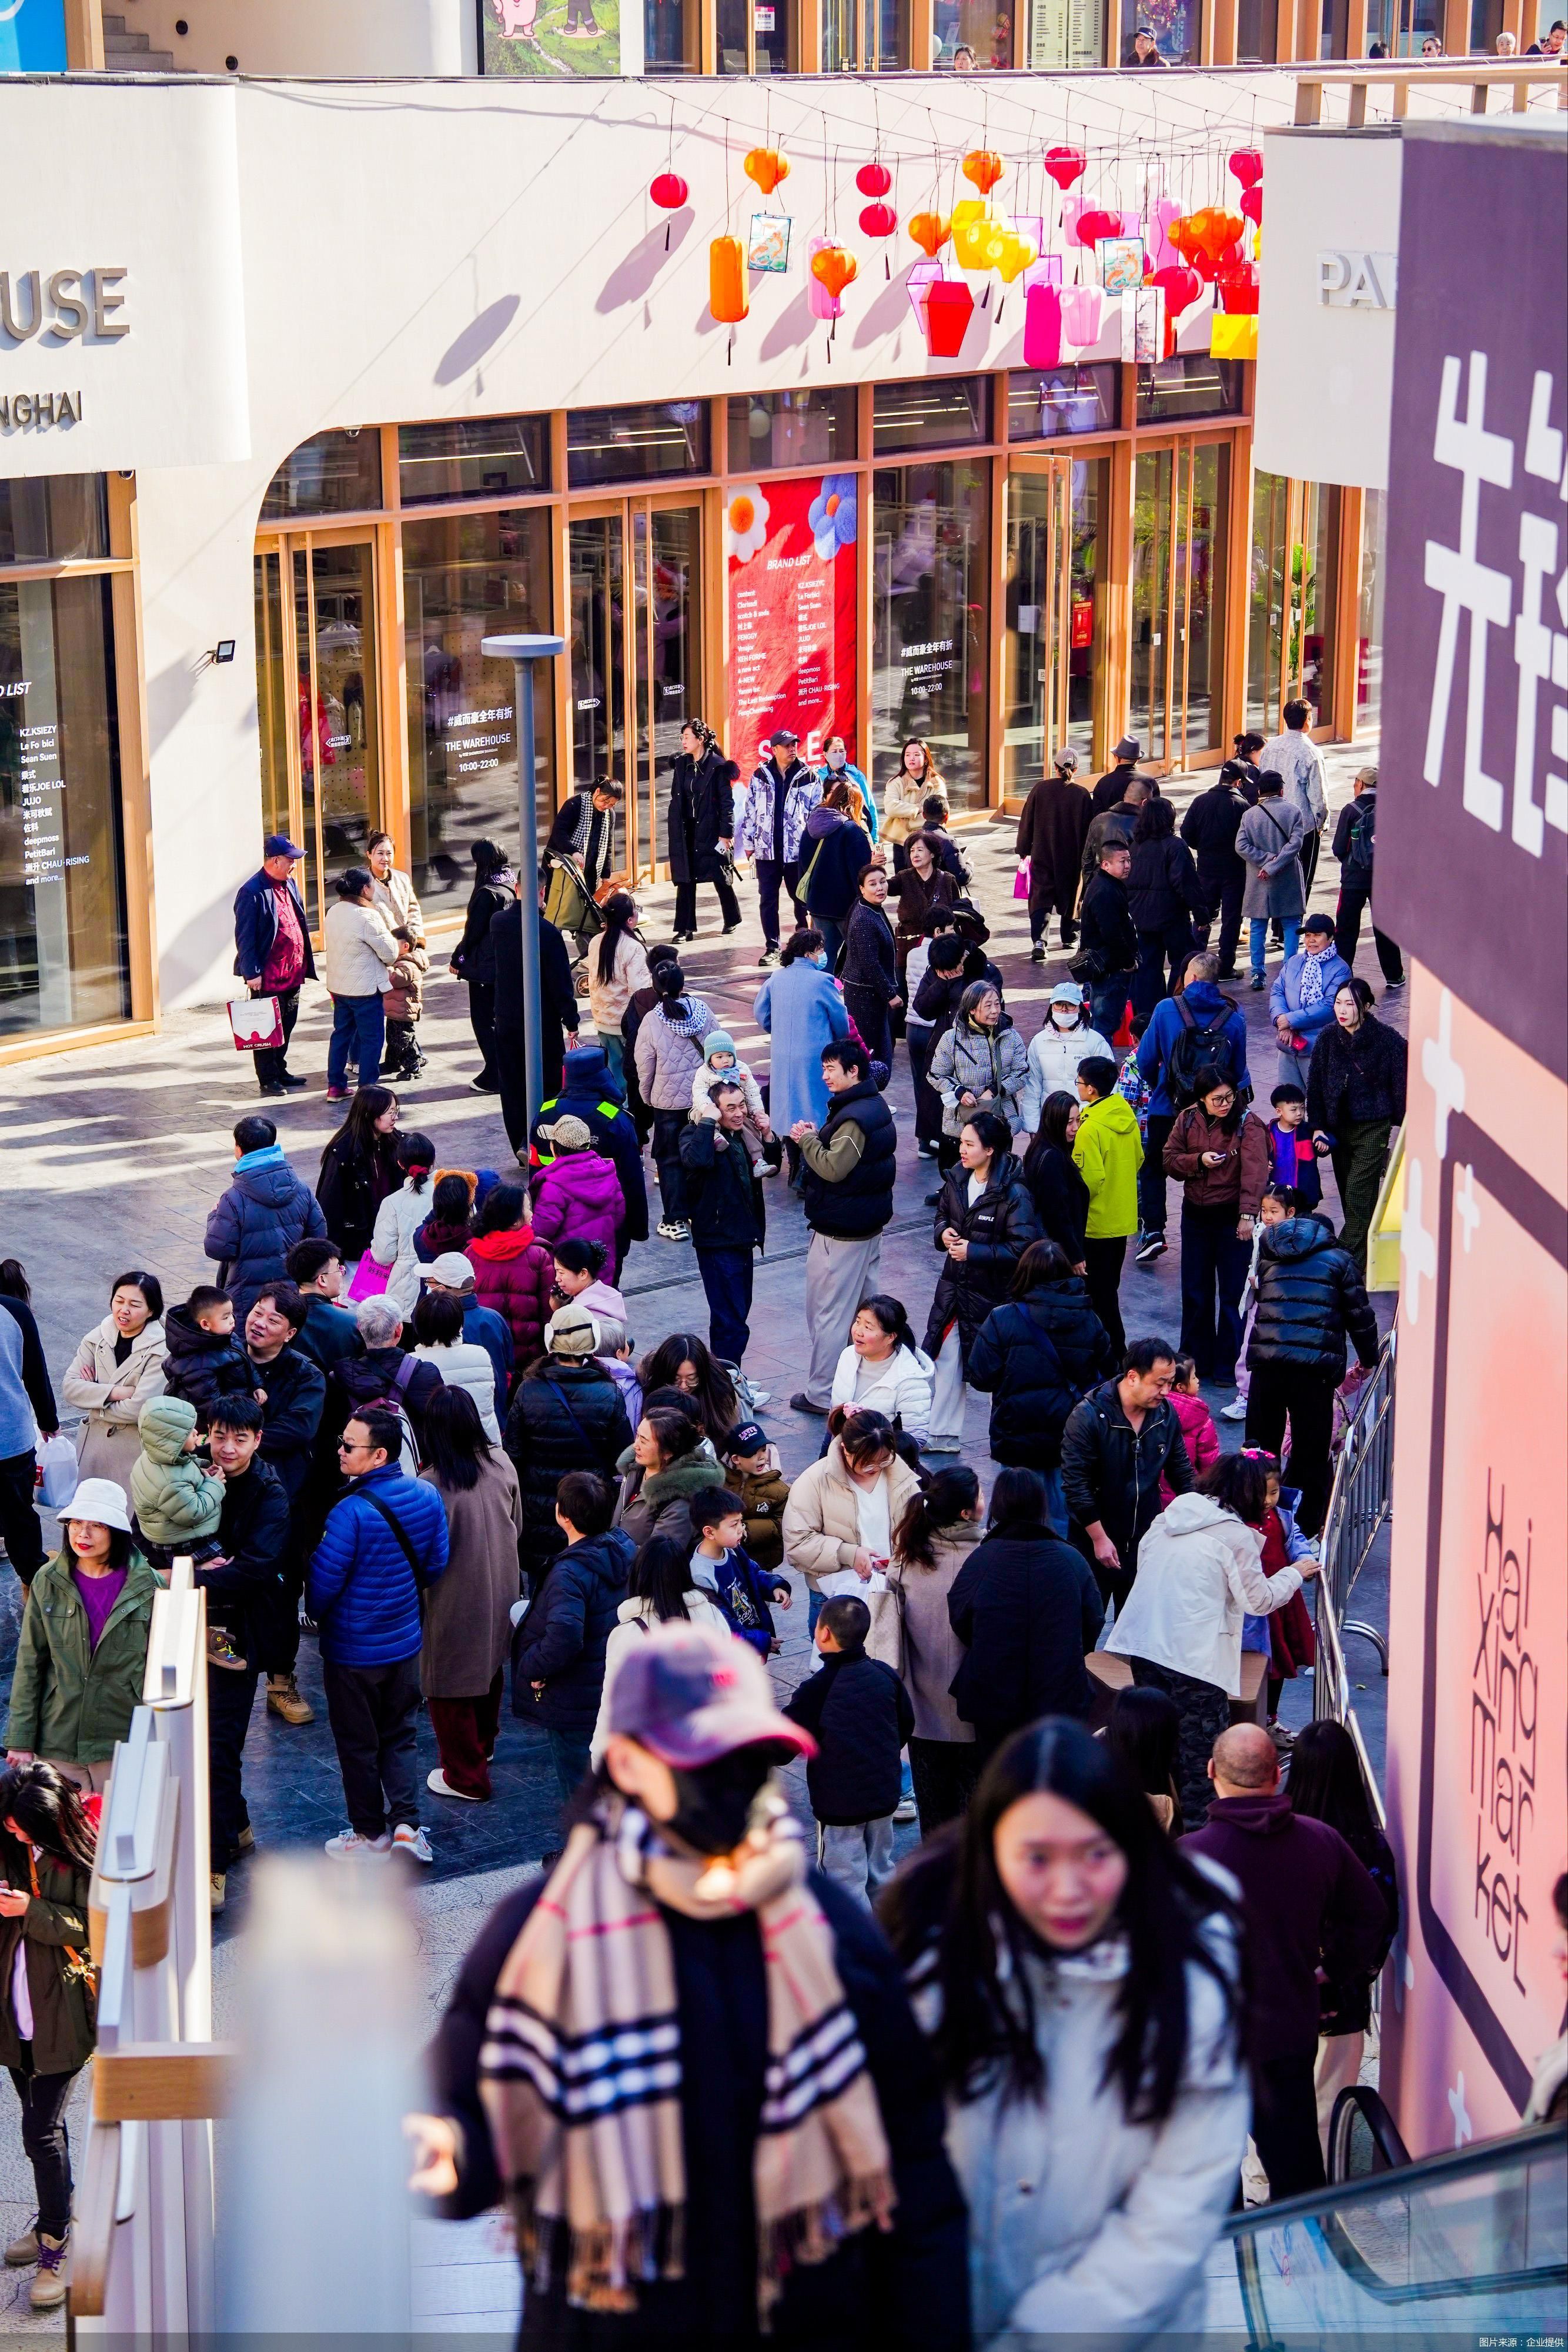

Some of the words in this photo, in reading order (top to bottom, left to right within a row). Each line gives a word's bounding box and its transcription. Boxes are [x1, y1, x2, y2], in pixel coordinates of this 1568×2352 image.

[767, 557, 794, 570] BRAND
[795, 554, 811, 566] LIST
[737, 590, 755, 598] content
[737, 611, 753, 620] scotch
[737, 632, 757, 642] FENGGY
[798, 635, 810, 643] JUJO
[738, 645, 754, 653] Vmajor
[748, 652, 767, 661] FORME
[798, 666, 821, 675] deepmoss
[901, 666, 914, 677] THE
[914, 660, 952, 675] WAREHOUSE
[738, 676, 755, 684] A-NEW
[798, 676, 818, 685] PetitBari
[6, 681, 32, 696] LIST
[911, 682, 942, 696] 10:00-22:00
[758, 693, 787, 703] Redemption
[738, 706, 774, 717] FengChenWang
[19, 725, 57, 737] KZ.KSIEZY
[20, 742, 29, 751] Le
[446, 740, 462, 752] THE
[462, 733, 511, 750] WAREHOUSE
[21, 755, 38, 764] Sean
[39, 753, 57, 761] Suen
[459, 758, 499, 773] 10:00-22:00
[52, 780, 66, 789] LOL
[22, 796, 42, 807] JUJO
[24, 834, 59, 846] deepmoss
[25, 847, 56, 859] PetitBari
[25, 876, 39, 885] and
[756, 1504, 769, 1512] Lee
